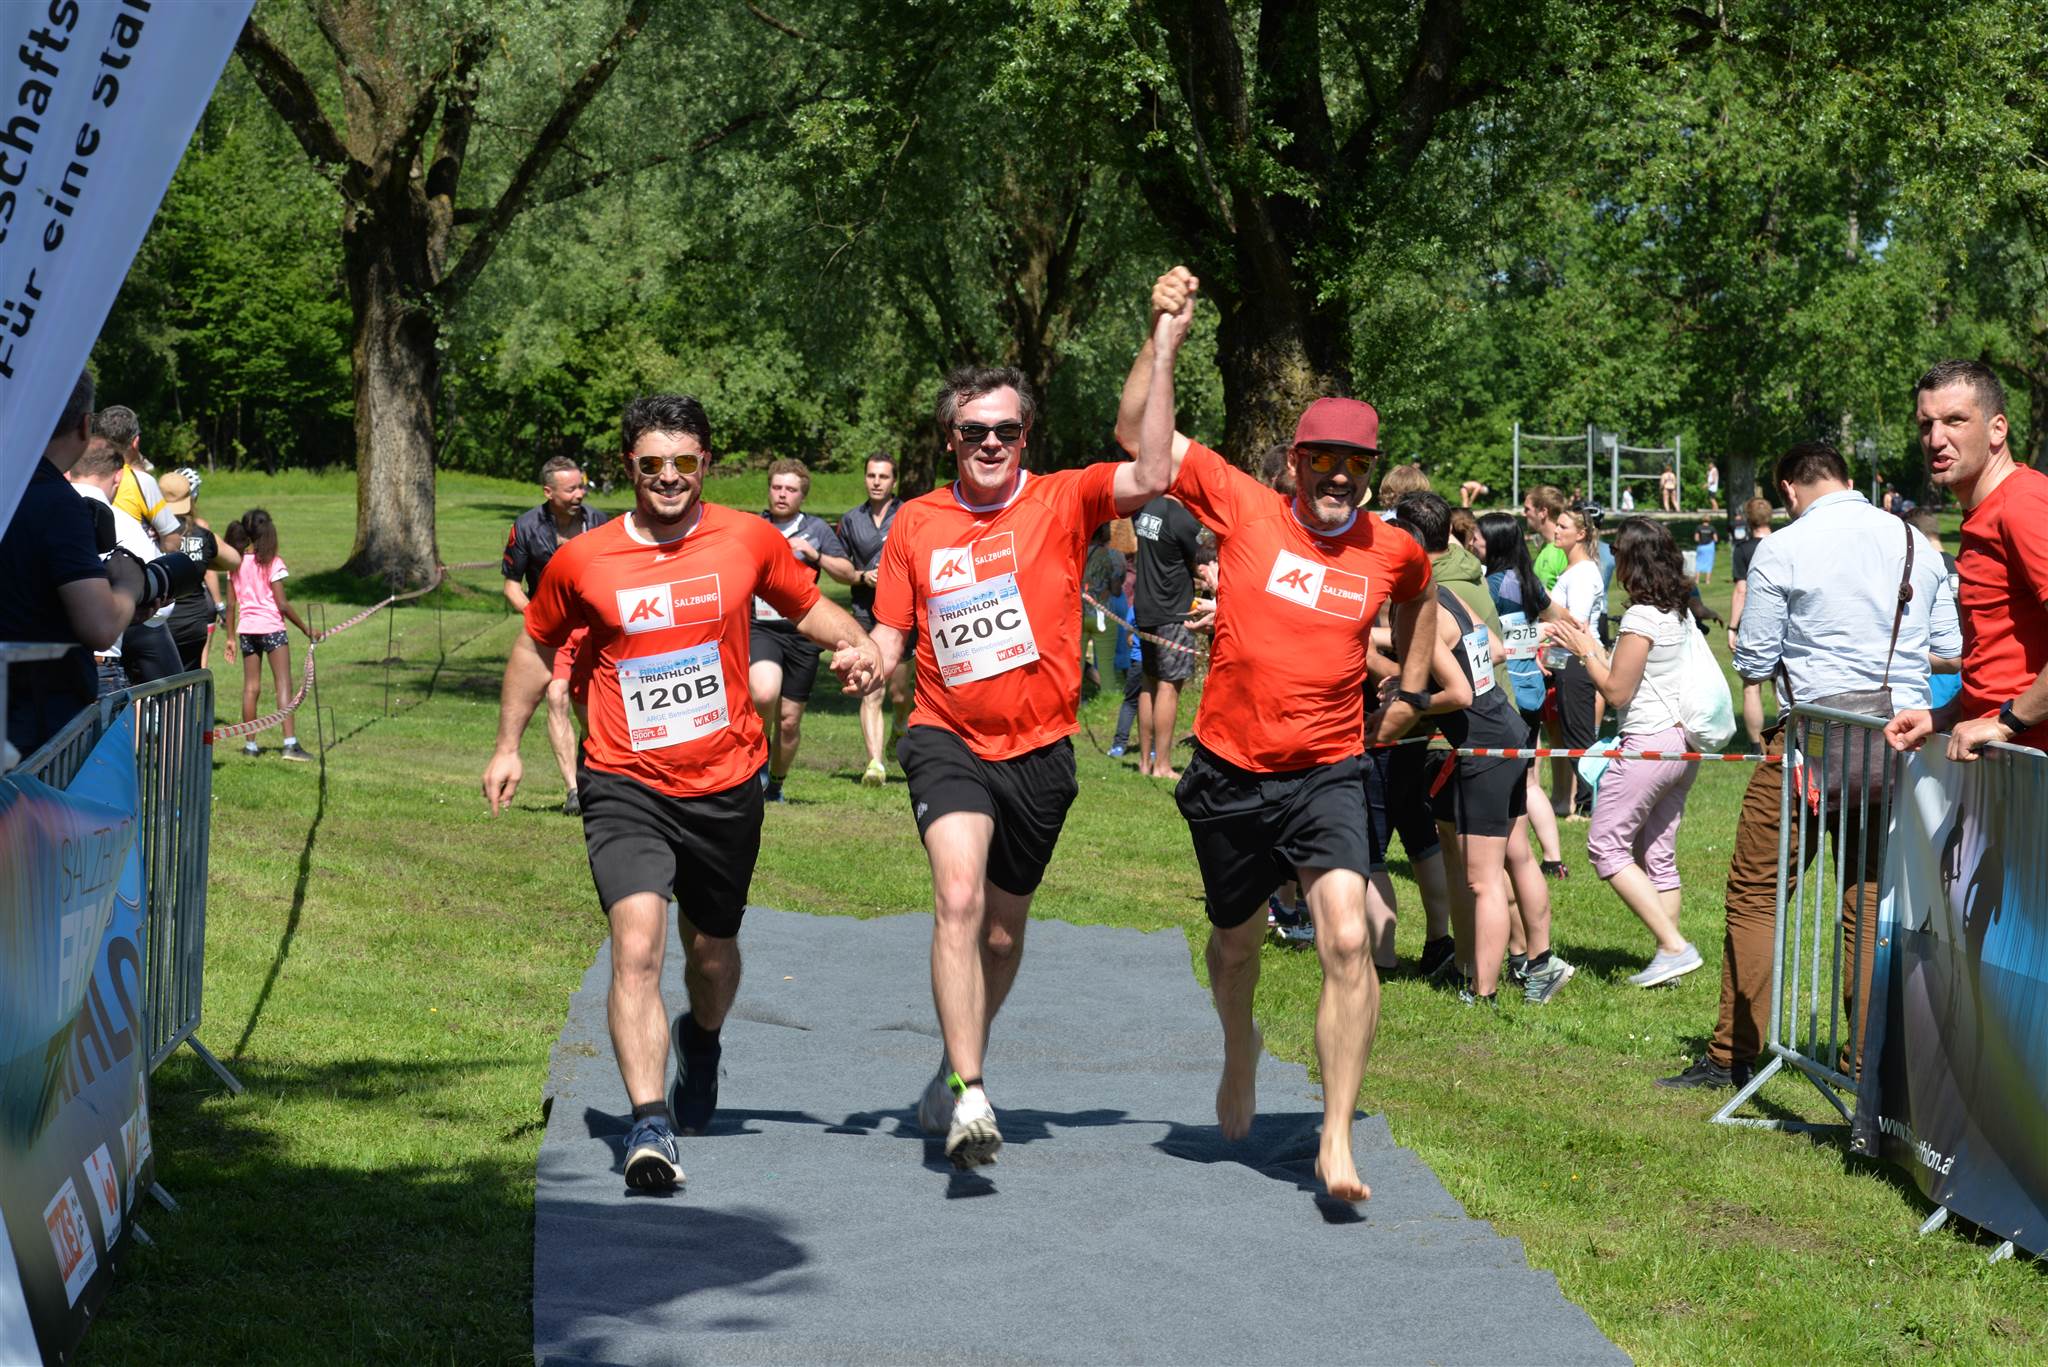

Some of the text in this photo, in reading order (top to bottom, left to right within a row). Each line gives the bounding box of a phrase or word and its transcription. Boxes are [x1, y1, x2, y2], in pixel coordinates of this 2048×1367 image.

[43, 122, 101, 252] eine
[934, 547, 1012, 580] AK SALZBURG
[1276, 568, 1365, 602] AK SALZBURG
[628, 593, 718, 623] AK SALZBURG
[940, 598, 999, 622] TRIATHLON
[935, 608, 1022, 649] 120C
[639, 664, 701, 684] TRIATHLON
[630, 674, 720, 712] 120B
